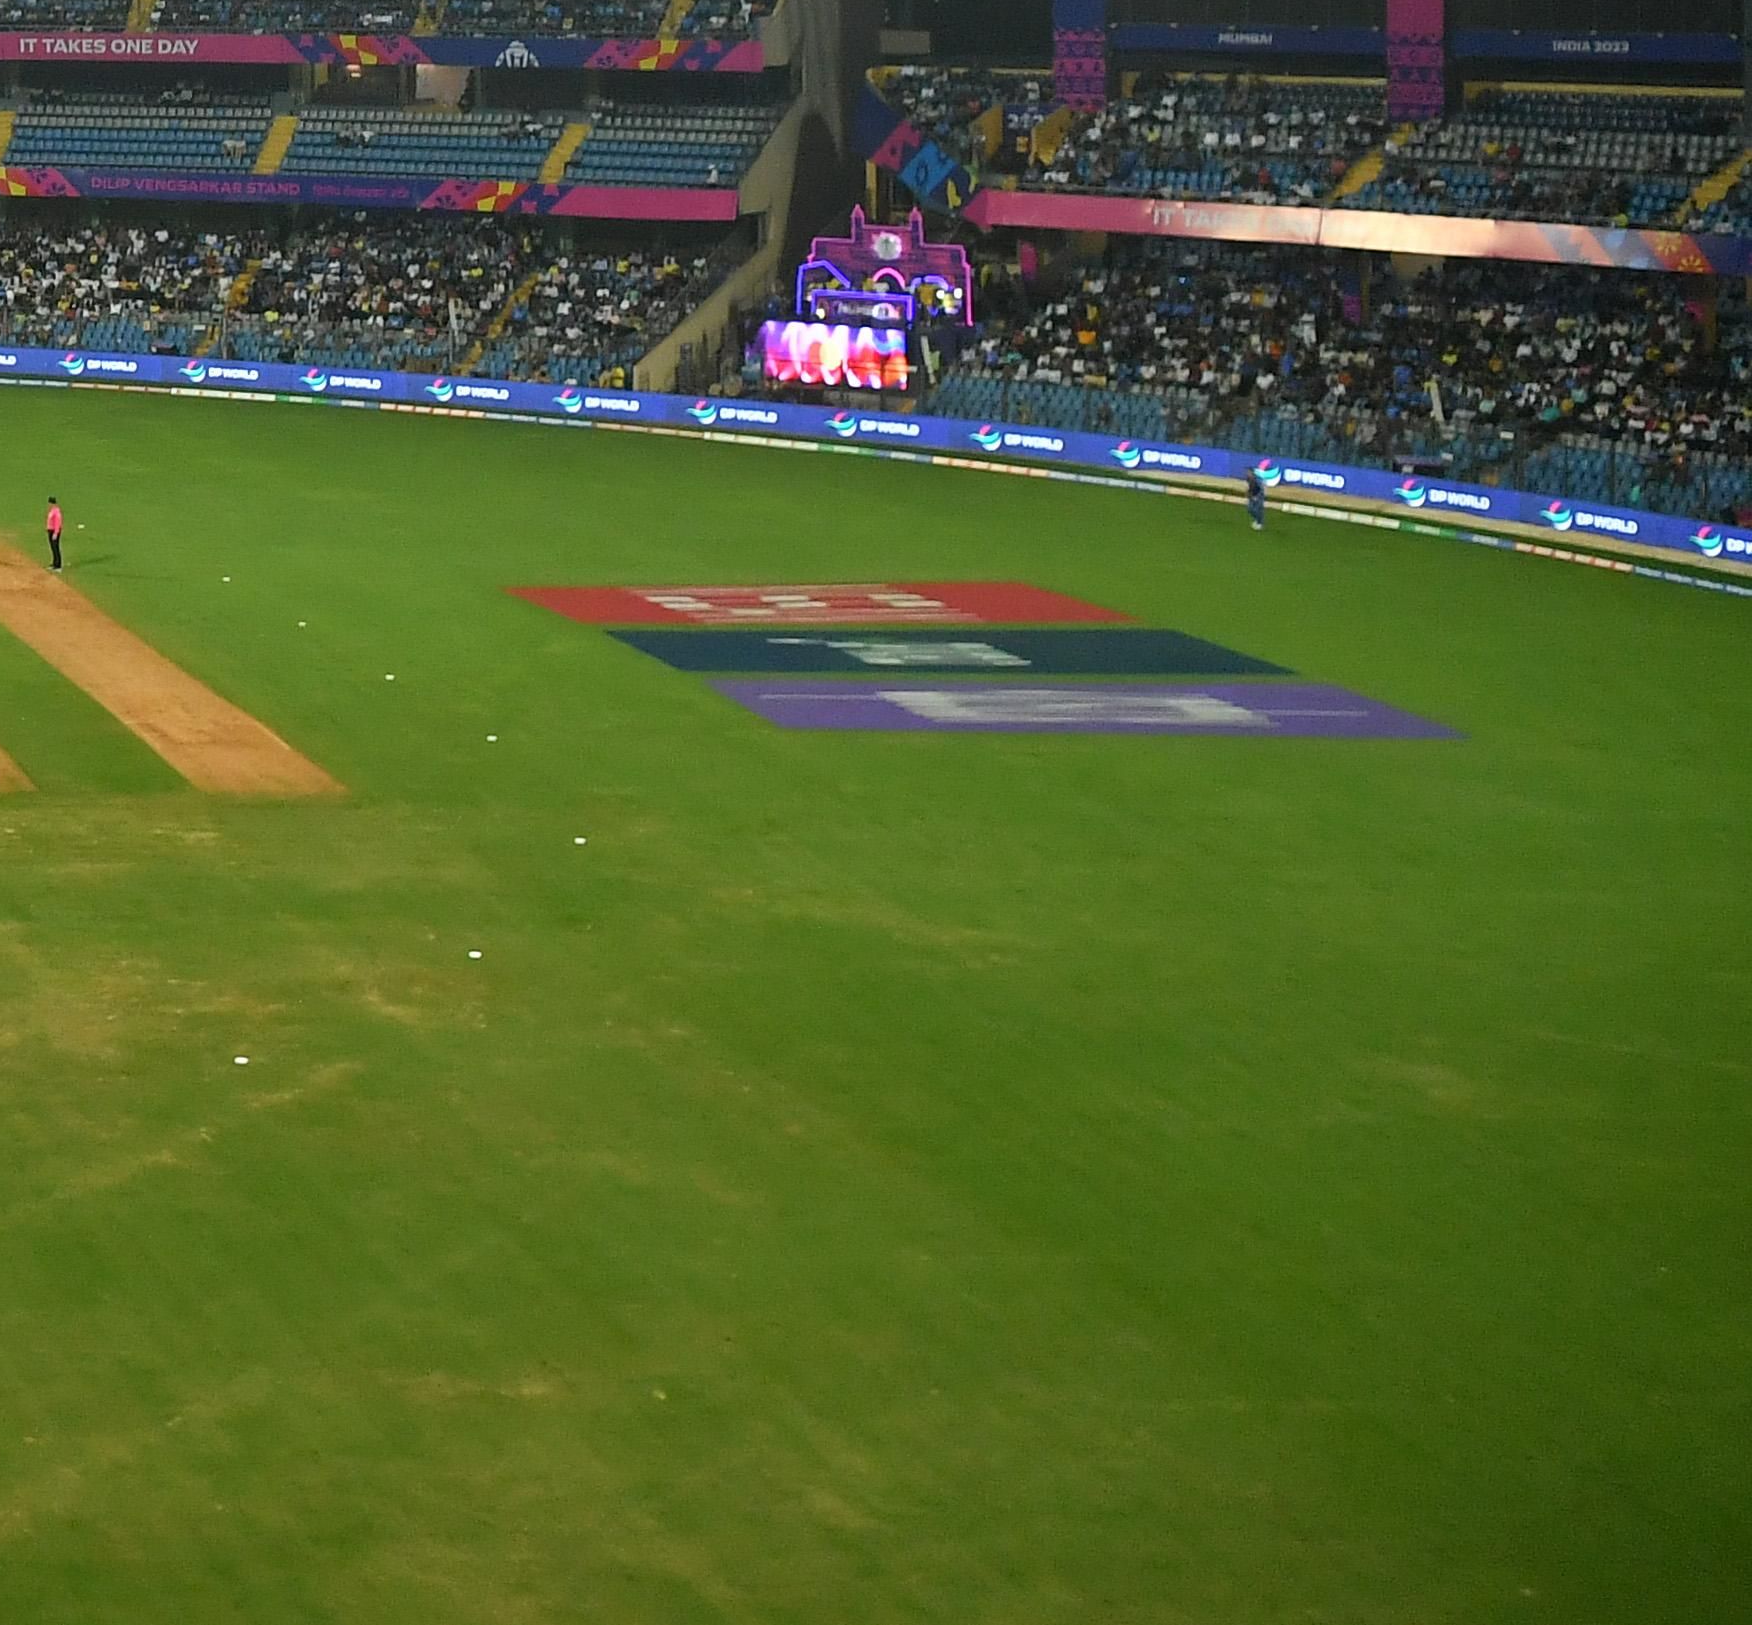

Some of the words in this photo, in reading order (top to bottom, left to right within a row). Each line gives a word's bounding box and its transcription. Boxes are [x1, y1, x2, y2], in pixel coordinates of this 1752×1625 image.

[19, 38, 38, 53] IT
[42, 38, 106, 54] TAKES
[110, 39, 153, 54] ONE
[157, 39, 199, 55] DAY
[1553, 40, 1591, 52] INDIA
[90, 177, 130, 190] DILIP
[133, 178, 242, 194] VENGSARKAR
[246, 181, 301, 196] STAND
[102, 360, 138, 373] WORLD
[223, 368, 259, 381] WORLD
[345, 377, 382, 390] WORLD
[471, 386, 510, 401] WORLD
[601, 398, 640, 412] WORLD
[737, 409, 778, 424] WORLD
[878, 421, 920, 437] WORLD
[1022, 435, 1064, 452] WORLD
[1160, 452, 1202, 469] WORLD
[1302, 471, 1345, 489] WORLD
[1448, 491, 1490, 510] WORLD
[1594, 515, 1638, 534] WORLD
[1725, 537, 1745, 553] DP
